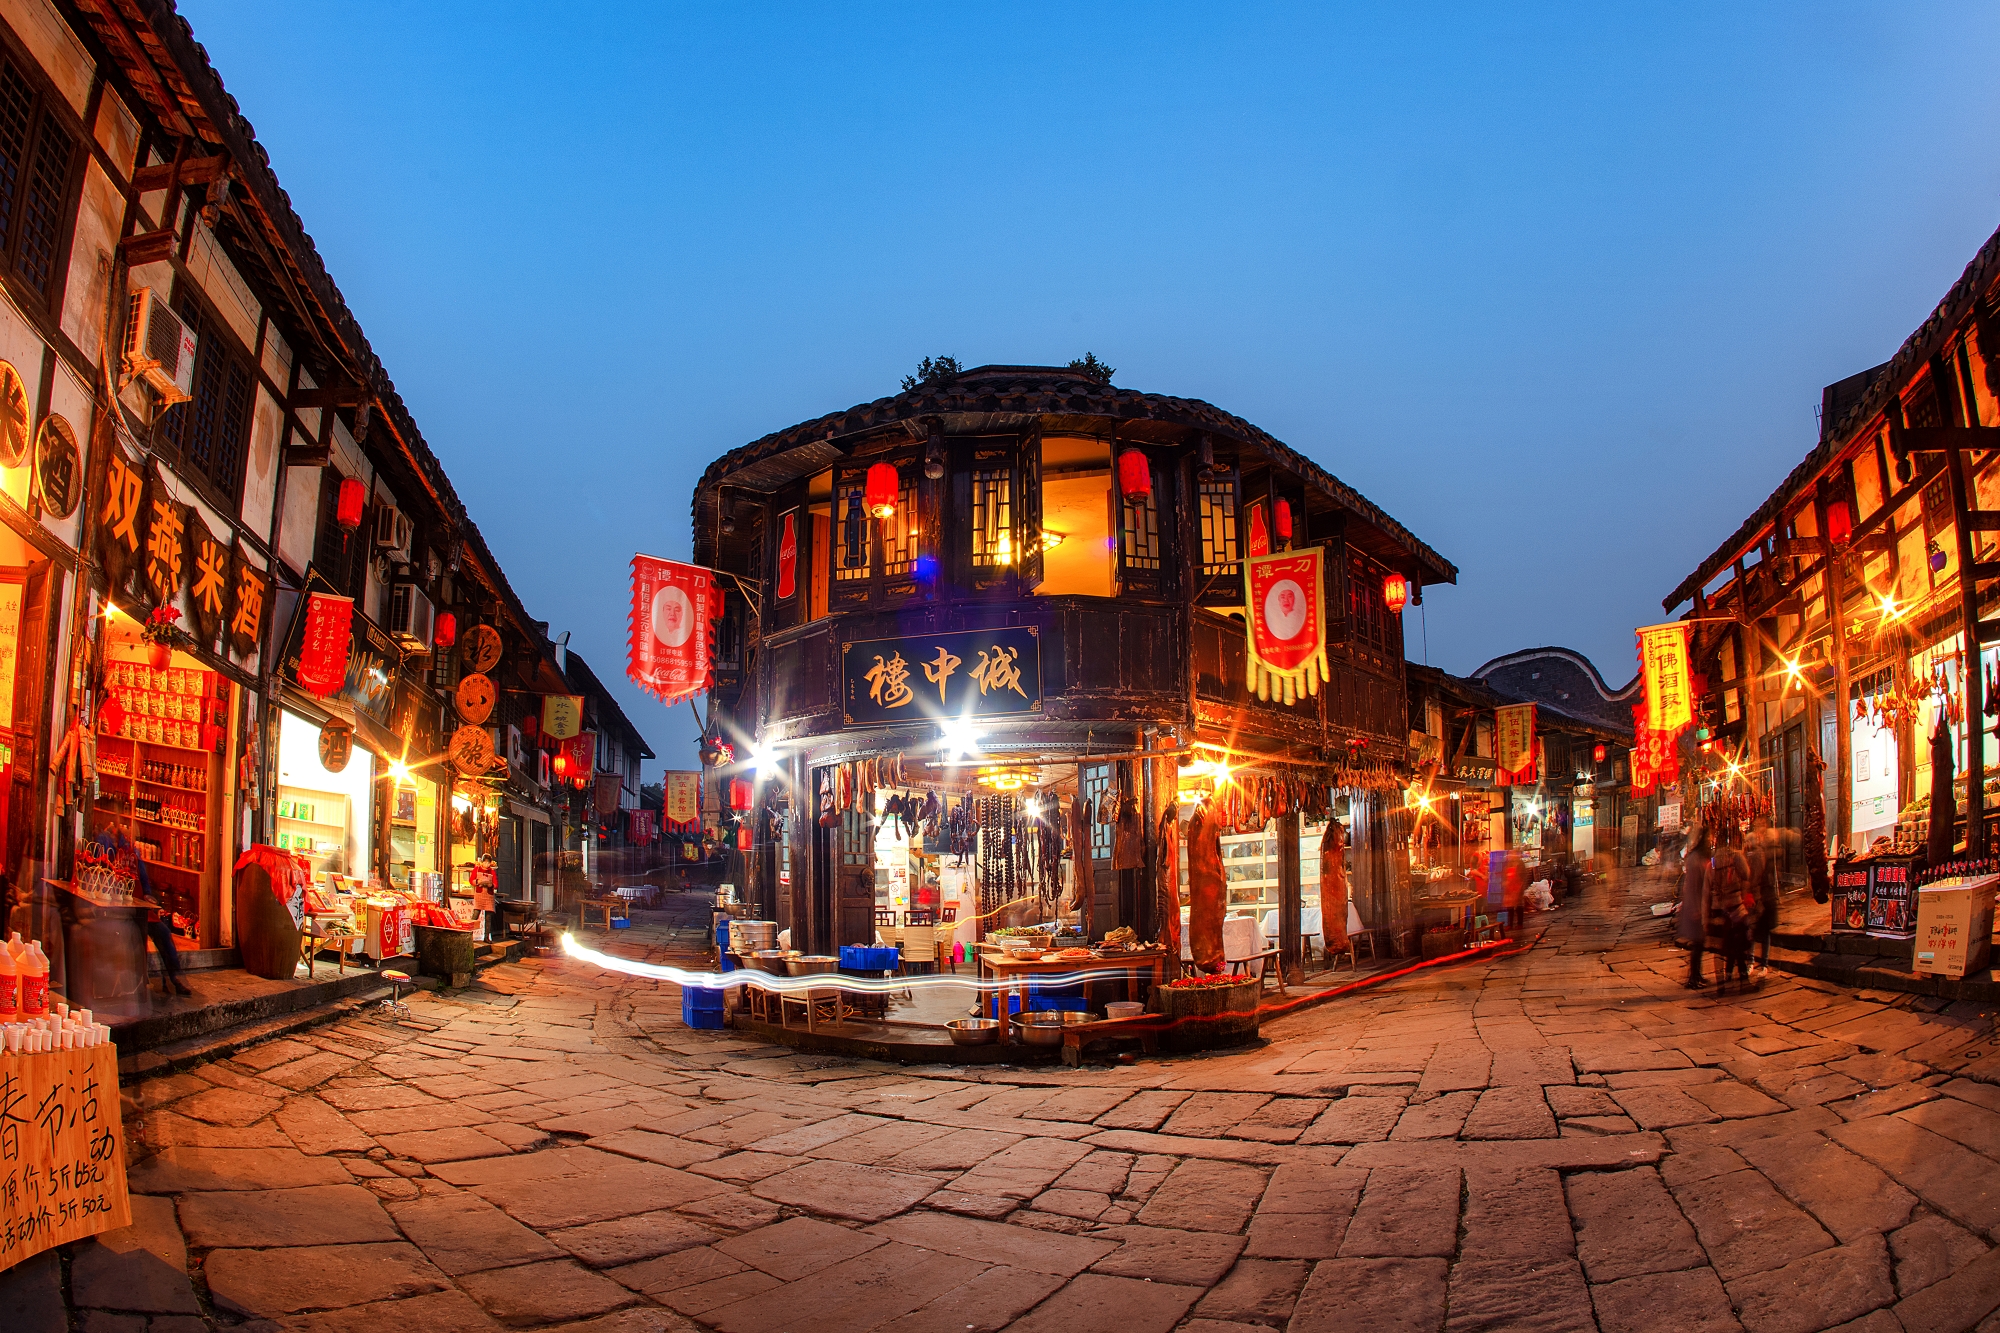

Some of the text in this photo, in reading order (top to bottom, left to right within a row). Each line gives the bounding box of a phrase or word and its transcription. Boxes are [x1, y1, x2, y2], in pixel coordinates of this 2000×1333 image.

[40, 417, 77, 515] 酒
[103, 454, 265, 643] 双燕米酒
[1256, 559, 1311, 578] 谭一刀
[658, 568, 706, 588] 谭一刀
[1655, 634, 1682, 710] 二佛酒家
[322, 726, 348, 765] 酒
